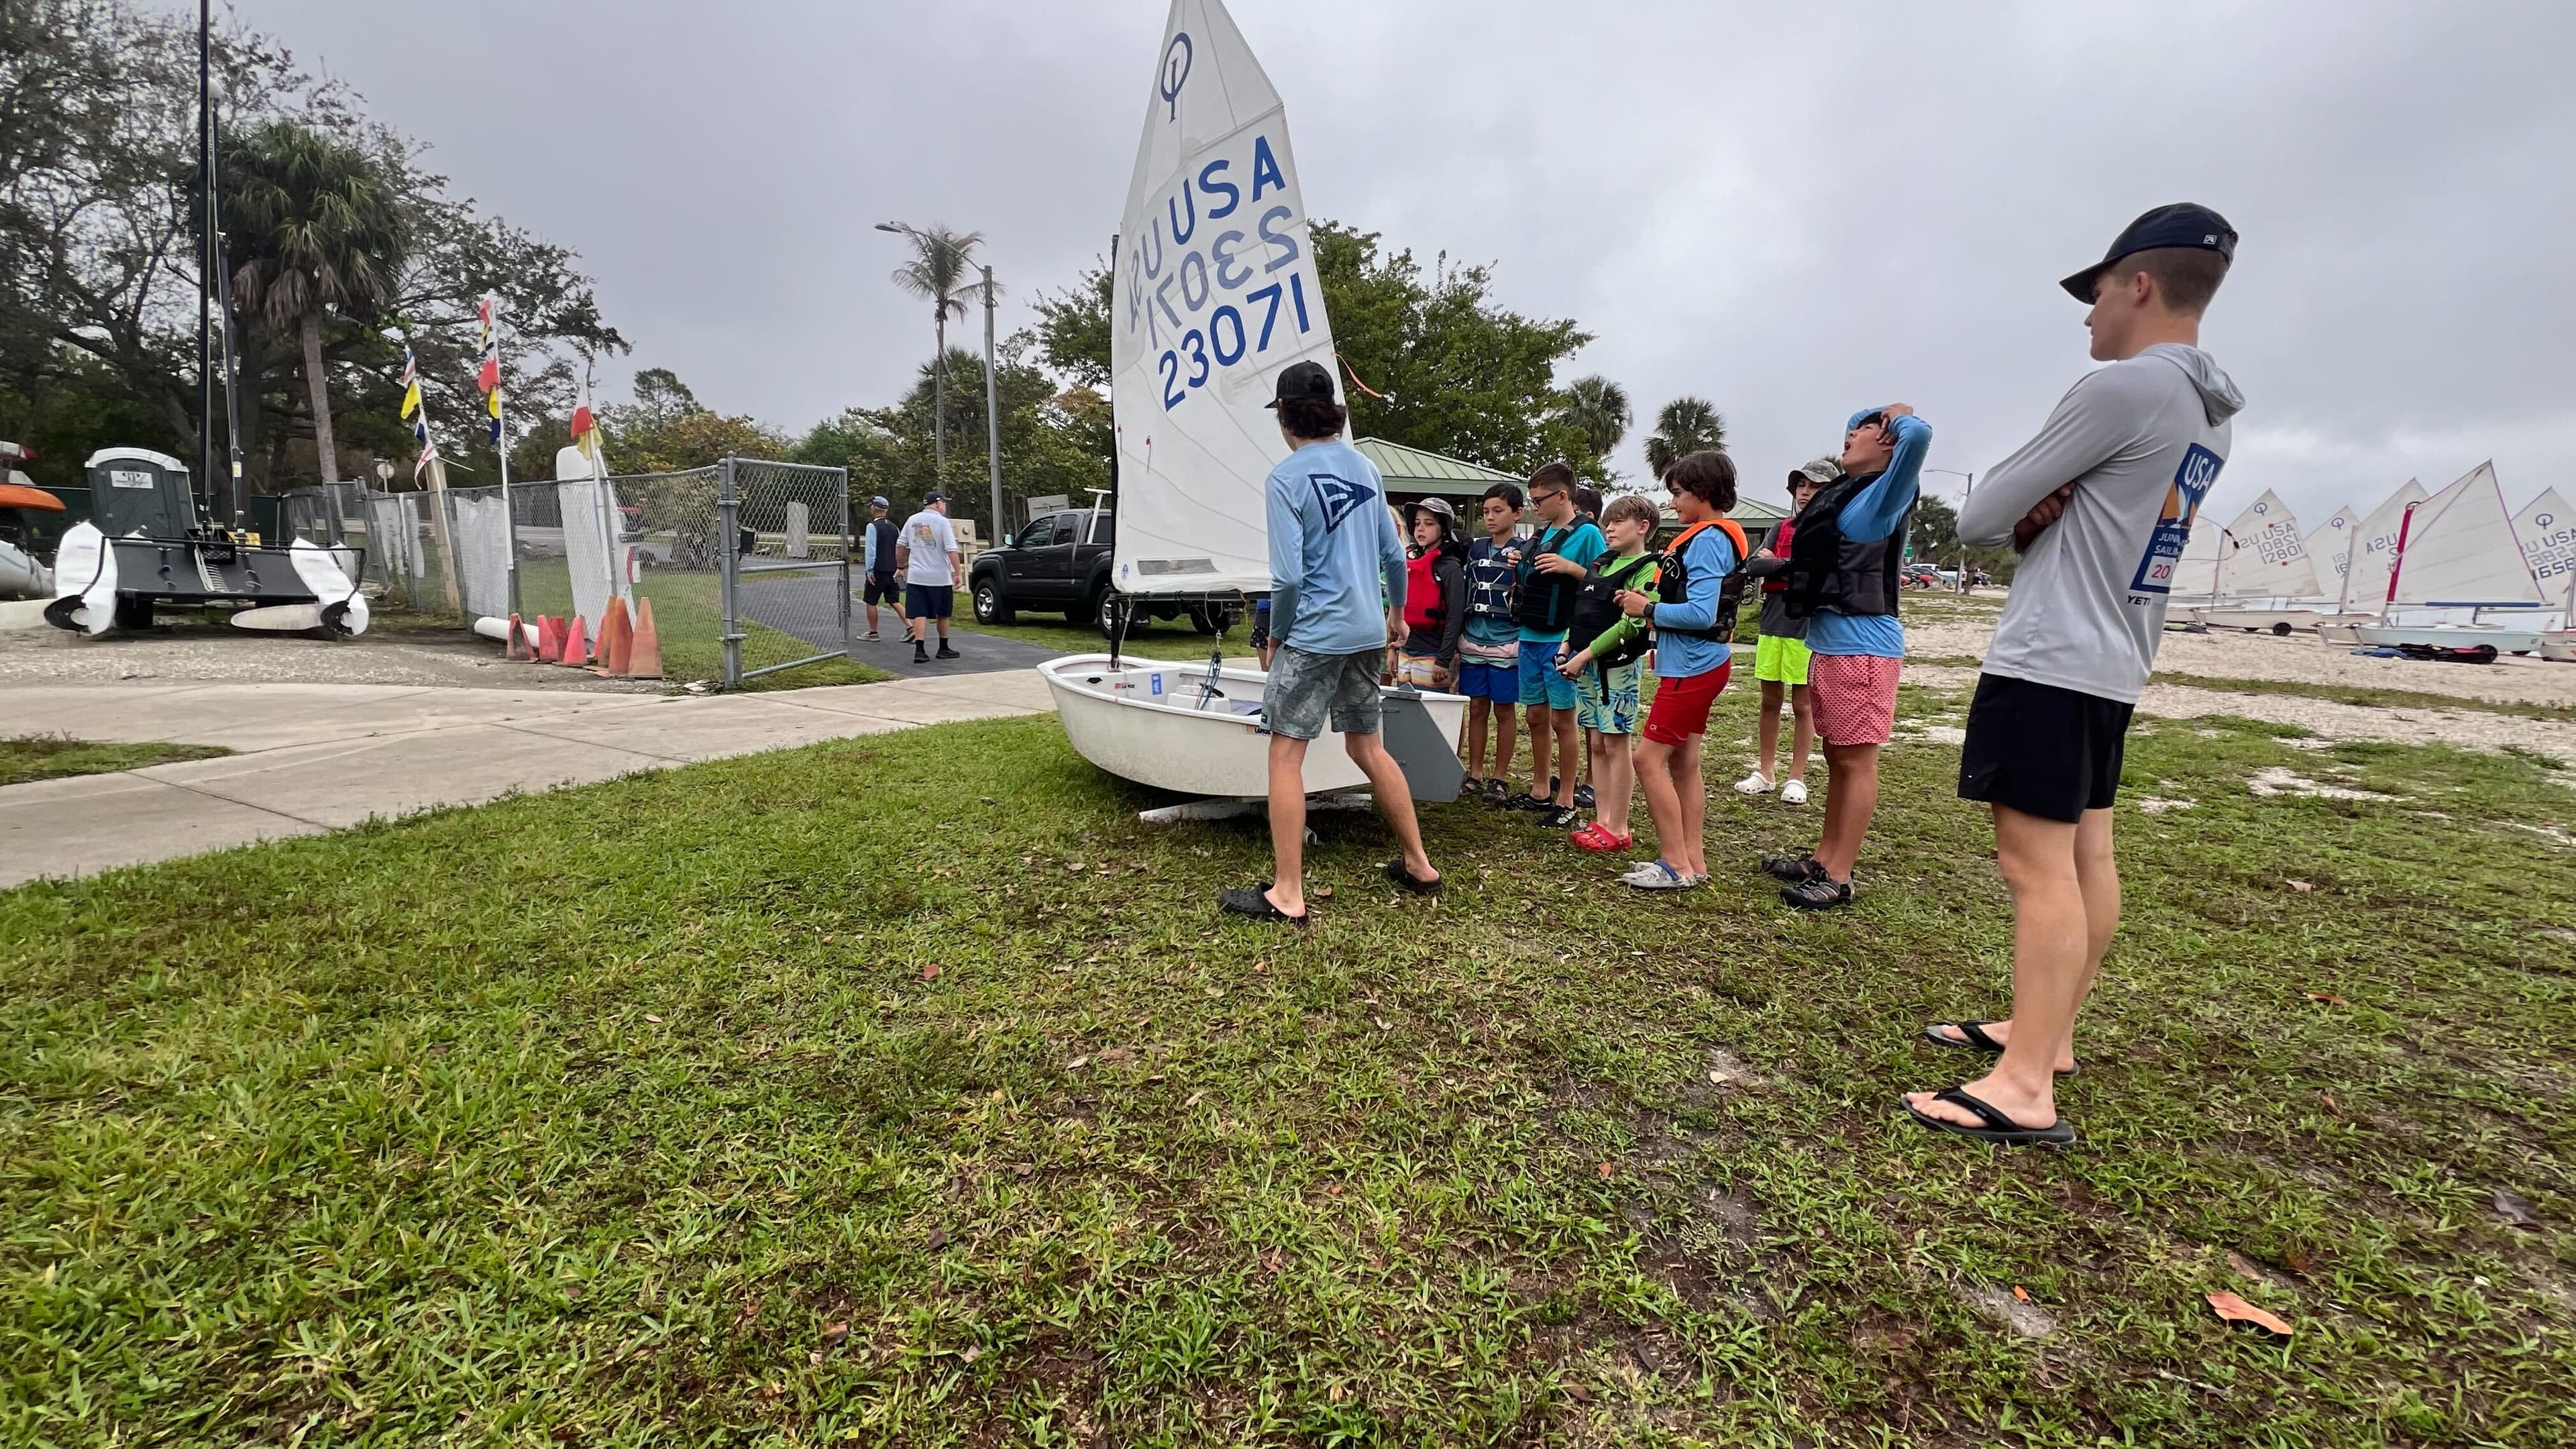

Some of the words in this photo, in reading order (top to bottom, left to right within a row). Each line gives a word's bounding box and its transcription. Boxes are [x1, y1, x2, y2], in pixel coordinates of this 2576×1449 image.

[1169, 135, 1286, 246] USA
[1159, 272, 1309, 413] 23071
[2184, 453, 2215, 494] USA
[2262, 523, 2295, 540] USA
[2261, 543, 2303, 565] 12801
[2151, 564, 2171, 580] 20
[2127, 595, 2151, 606] YETI
